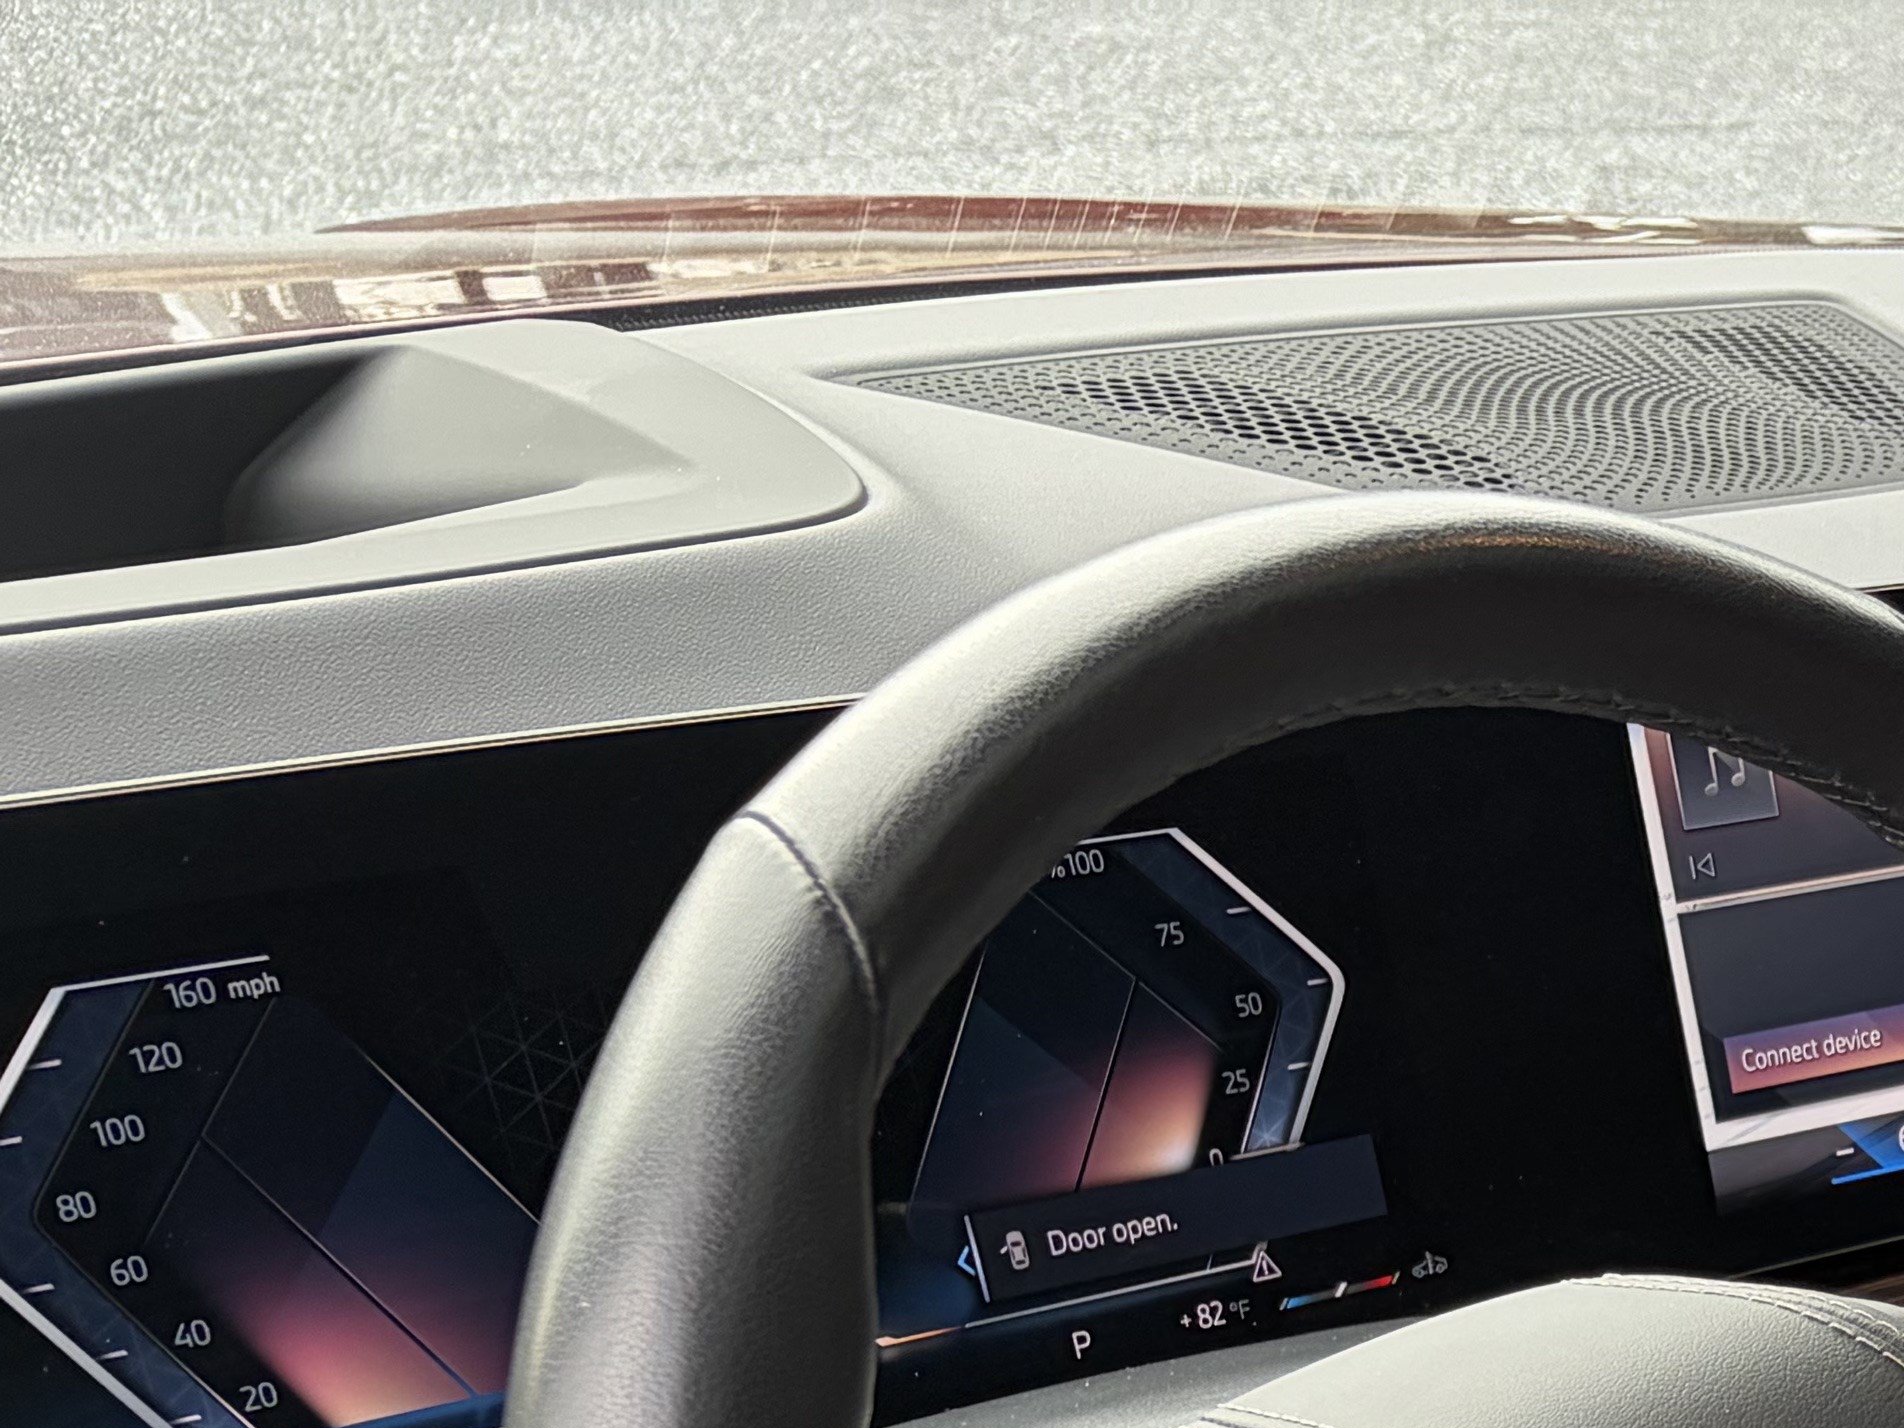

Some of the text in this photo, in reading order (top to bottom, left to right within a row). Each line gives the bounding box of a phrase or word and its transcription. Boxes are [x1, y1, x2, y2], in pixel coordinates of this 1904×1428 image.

[1154, 921, 1185, 947] 75
[162, 971, 282, 1009] 160 mph
[1234, 991, 1263, 1018] 50
[128, 1041, 184, 1074] 120
[1741, 1028, 1883, 1073] Connect device
[1221, 1068, 1250, 1095] 25
[89, 1114, 146, 1147] 100
[55, 1190, 97, 1223] 80
[1046, 1212, 1179, 1257] Door open.
[109, 1254, 149, 1287] 60
[173, 1318, 212, 1349] 40
[1071, 1330, 1091, 1360] P
[238, 1381, 279, 1413] 20
